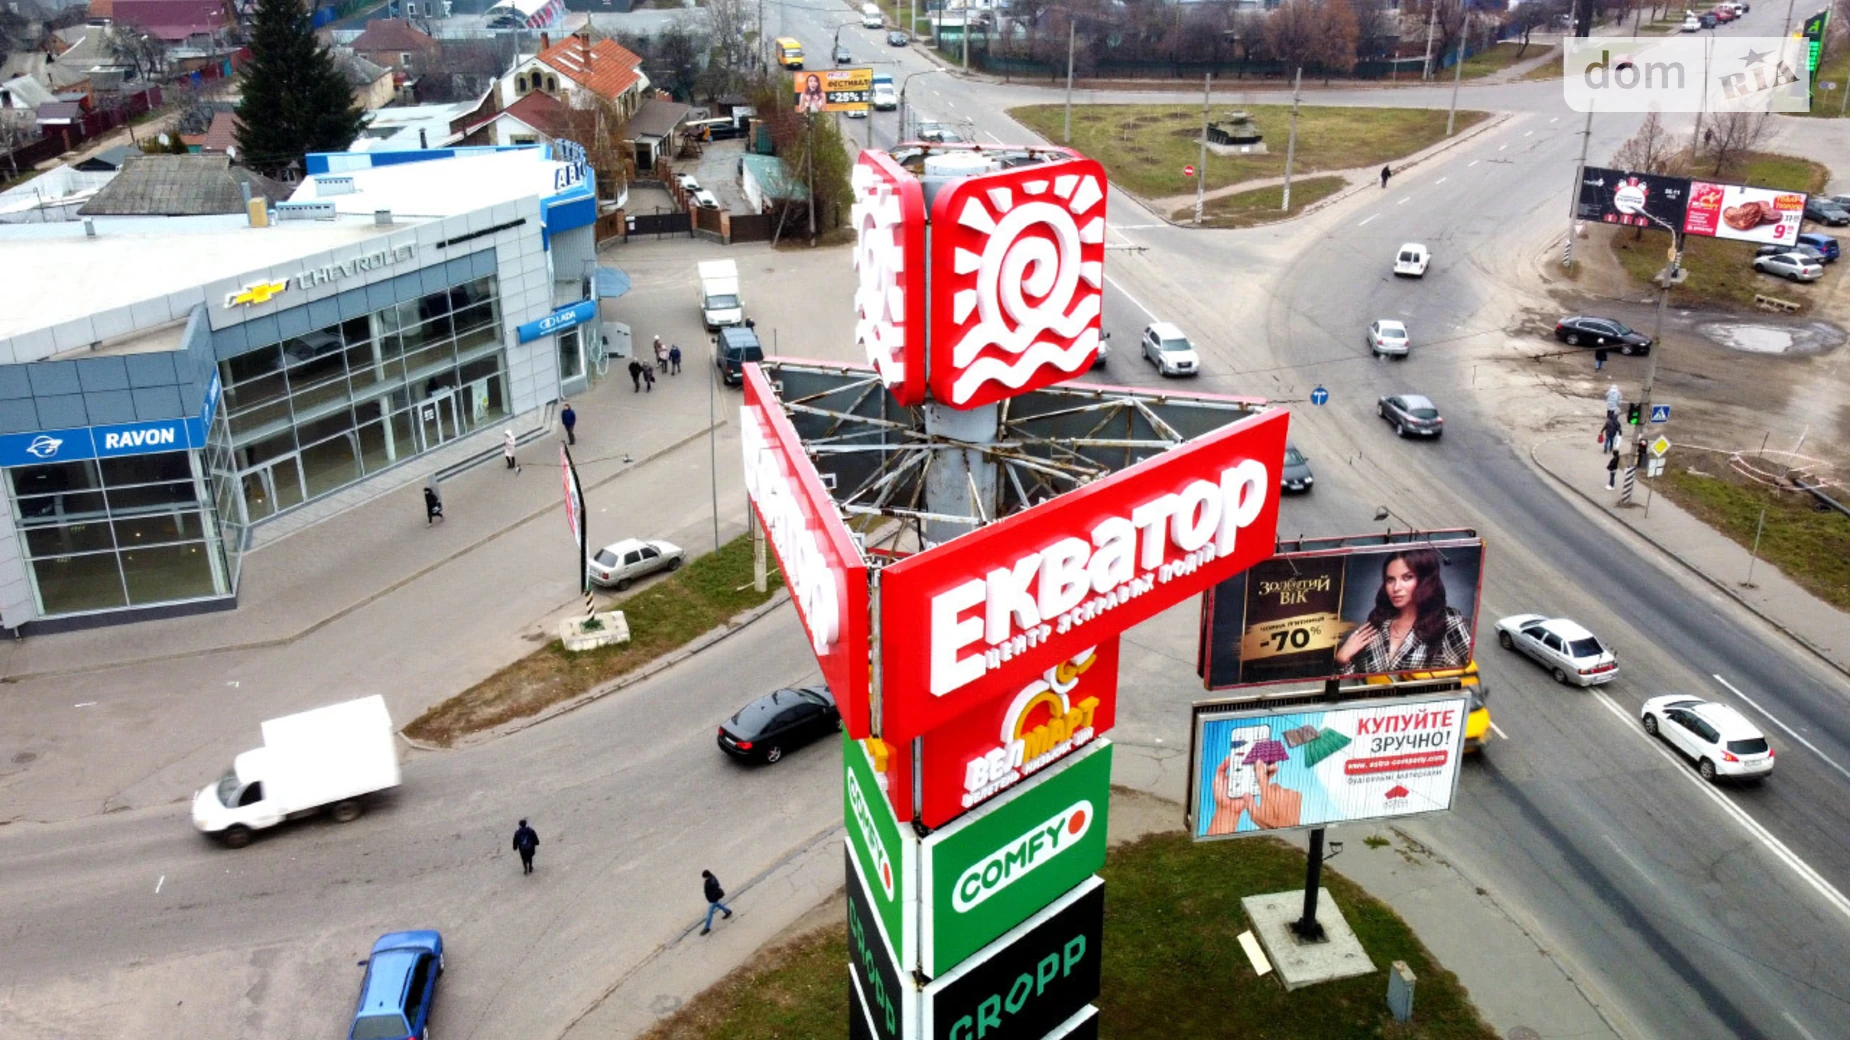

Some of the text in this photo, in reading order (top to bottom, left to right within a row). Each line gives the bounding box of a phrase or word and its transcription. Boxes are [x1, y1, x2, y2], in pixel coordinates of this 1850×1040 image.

[1773, 224, 1786, 239] 9
[297, 241, 417, 290] CHEVROLET
[555, 310, 576, 324] LADA
[105, 428, 175, 449] RAVON
[985, 624, 1051, 669] ЦЕНТР
[1056, 573, 1154, 634] ЯСКРАВИХ
[1357, 709, 1455, 735] КУПУЙТЕ
[1371, 731, 1451, 753] ЗРУЧНО!
[960, 817, 1066, 904] COMFY
